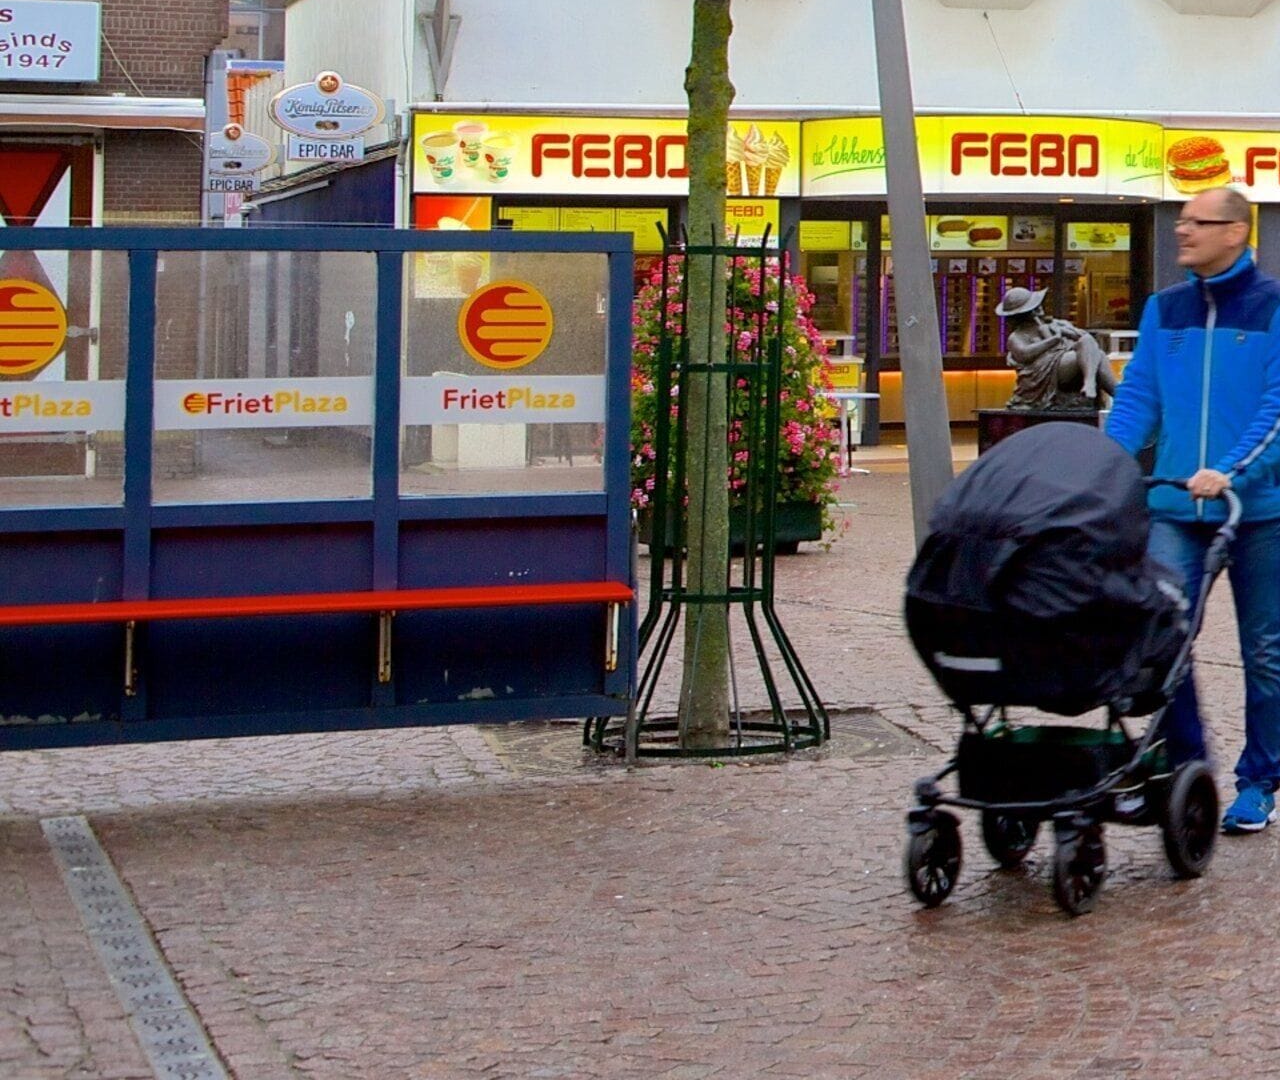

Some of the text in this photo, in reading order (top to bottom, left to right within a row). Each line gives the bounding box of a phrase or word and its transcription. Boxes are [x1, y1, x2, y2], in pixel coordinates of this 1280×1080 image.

[0, 32, 72, 53] sinds
[3, 53, 66, 68] 1947
[298, 144, 355, 159] EPIC BAR
[531, 133, 690, 178] FEBO
[951, 132, 1099, 177] FEBO
[210, 179, 254, 191] EPIC BAR
[207, 391, 347, 413] FrietPlaza
[443, 387, 576, 410] FrietPlaza
